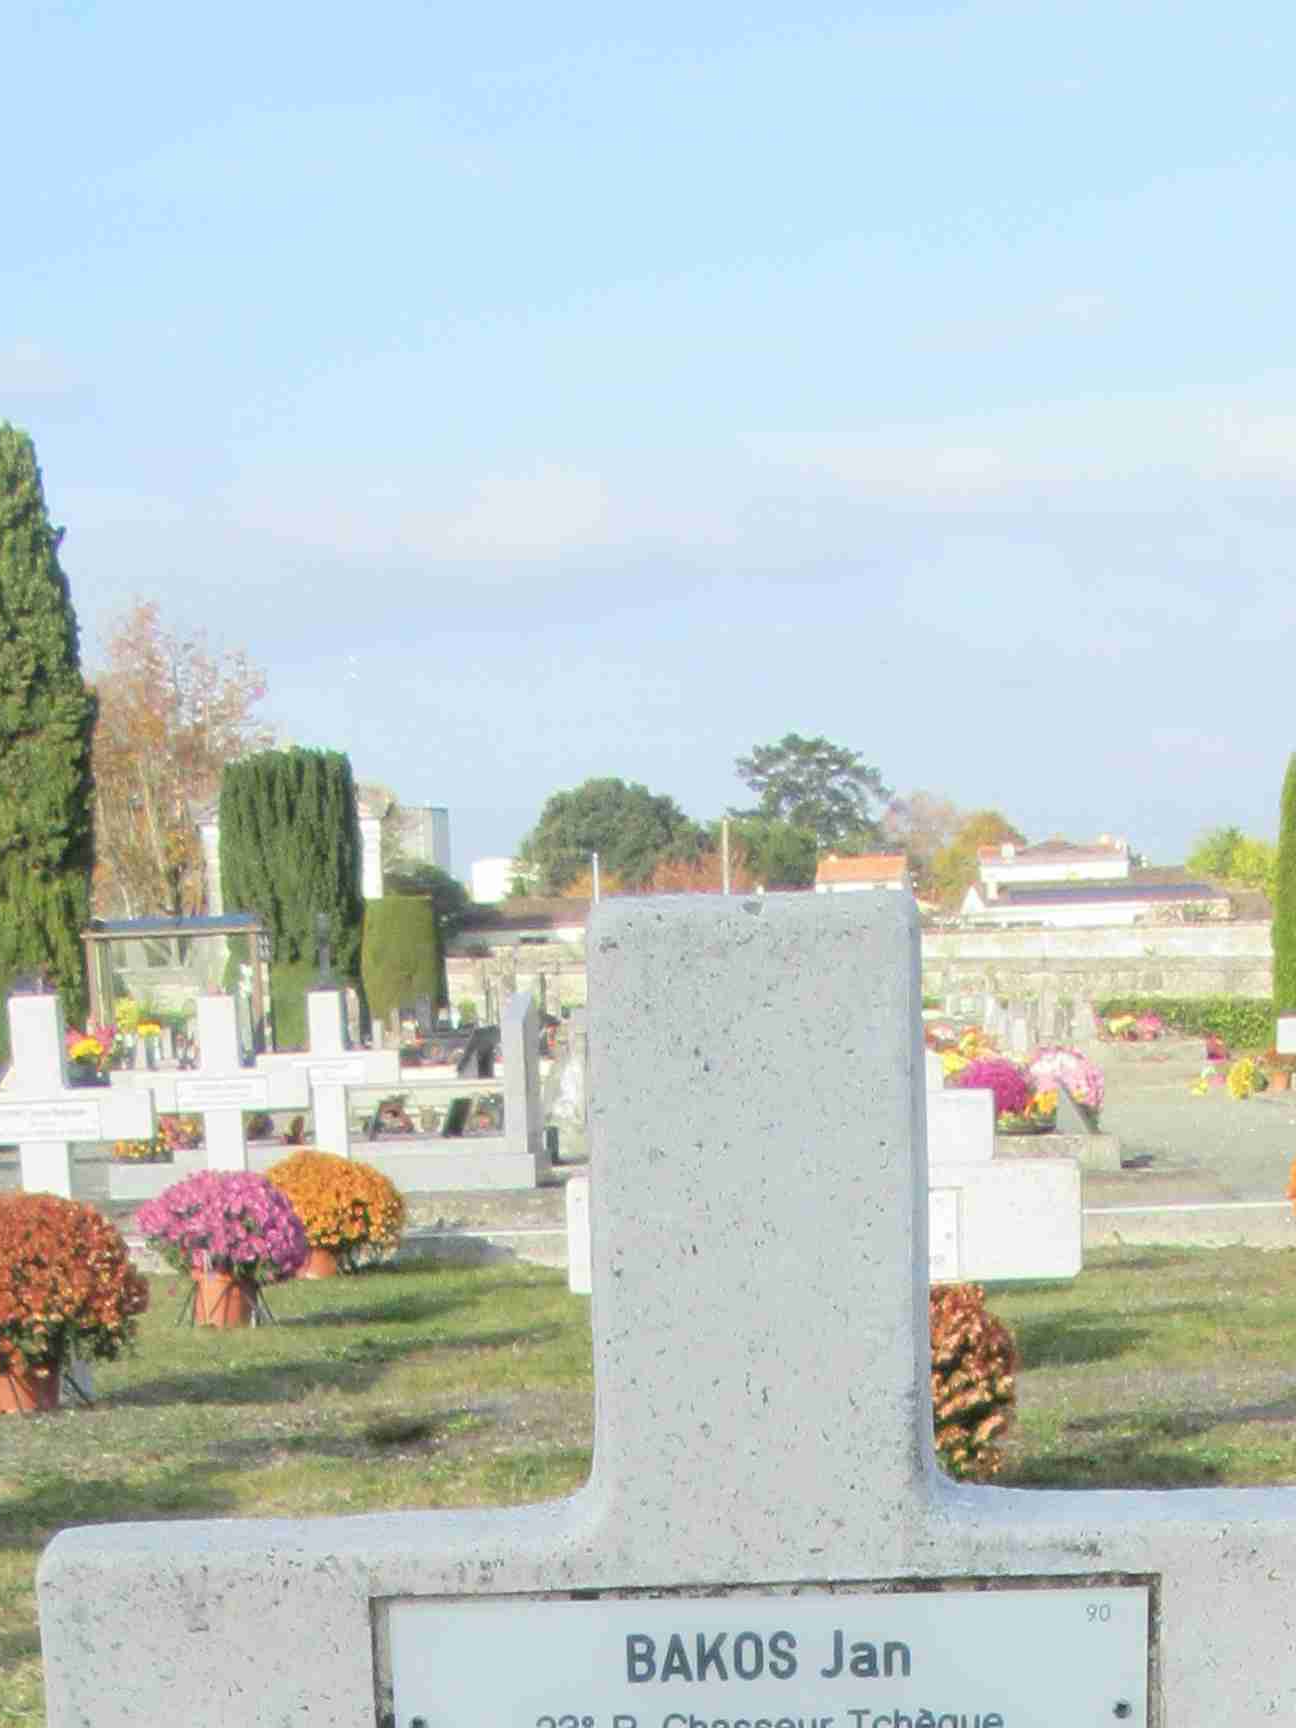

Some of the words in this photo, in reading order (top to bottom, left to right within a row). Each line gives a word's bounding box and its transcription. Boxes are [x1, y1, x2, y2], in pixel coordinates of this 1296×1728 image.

[1086, 1603, 1111, 1622] 90
[626, 1630, 798, 1683] BAKOS
[820, 1629, 912, 1679] Jan
